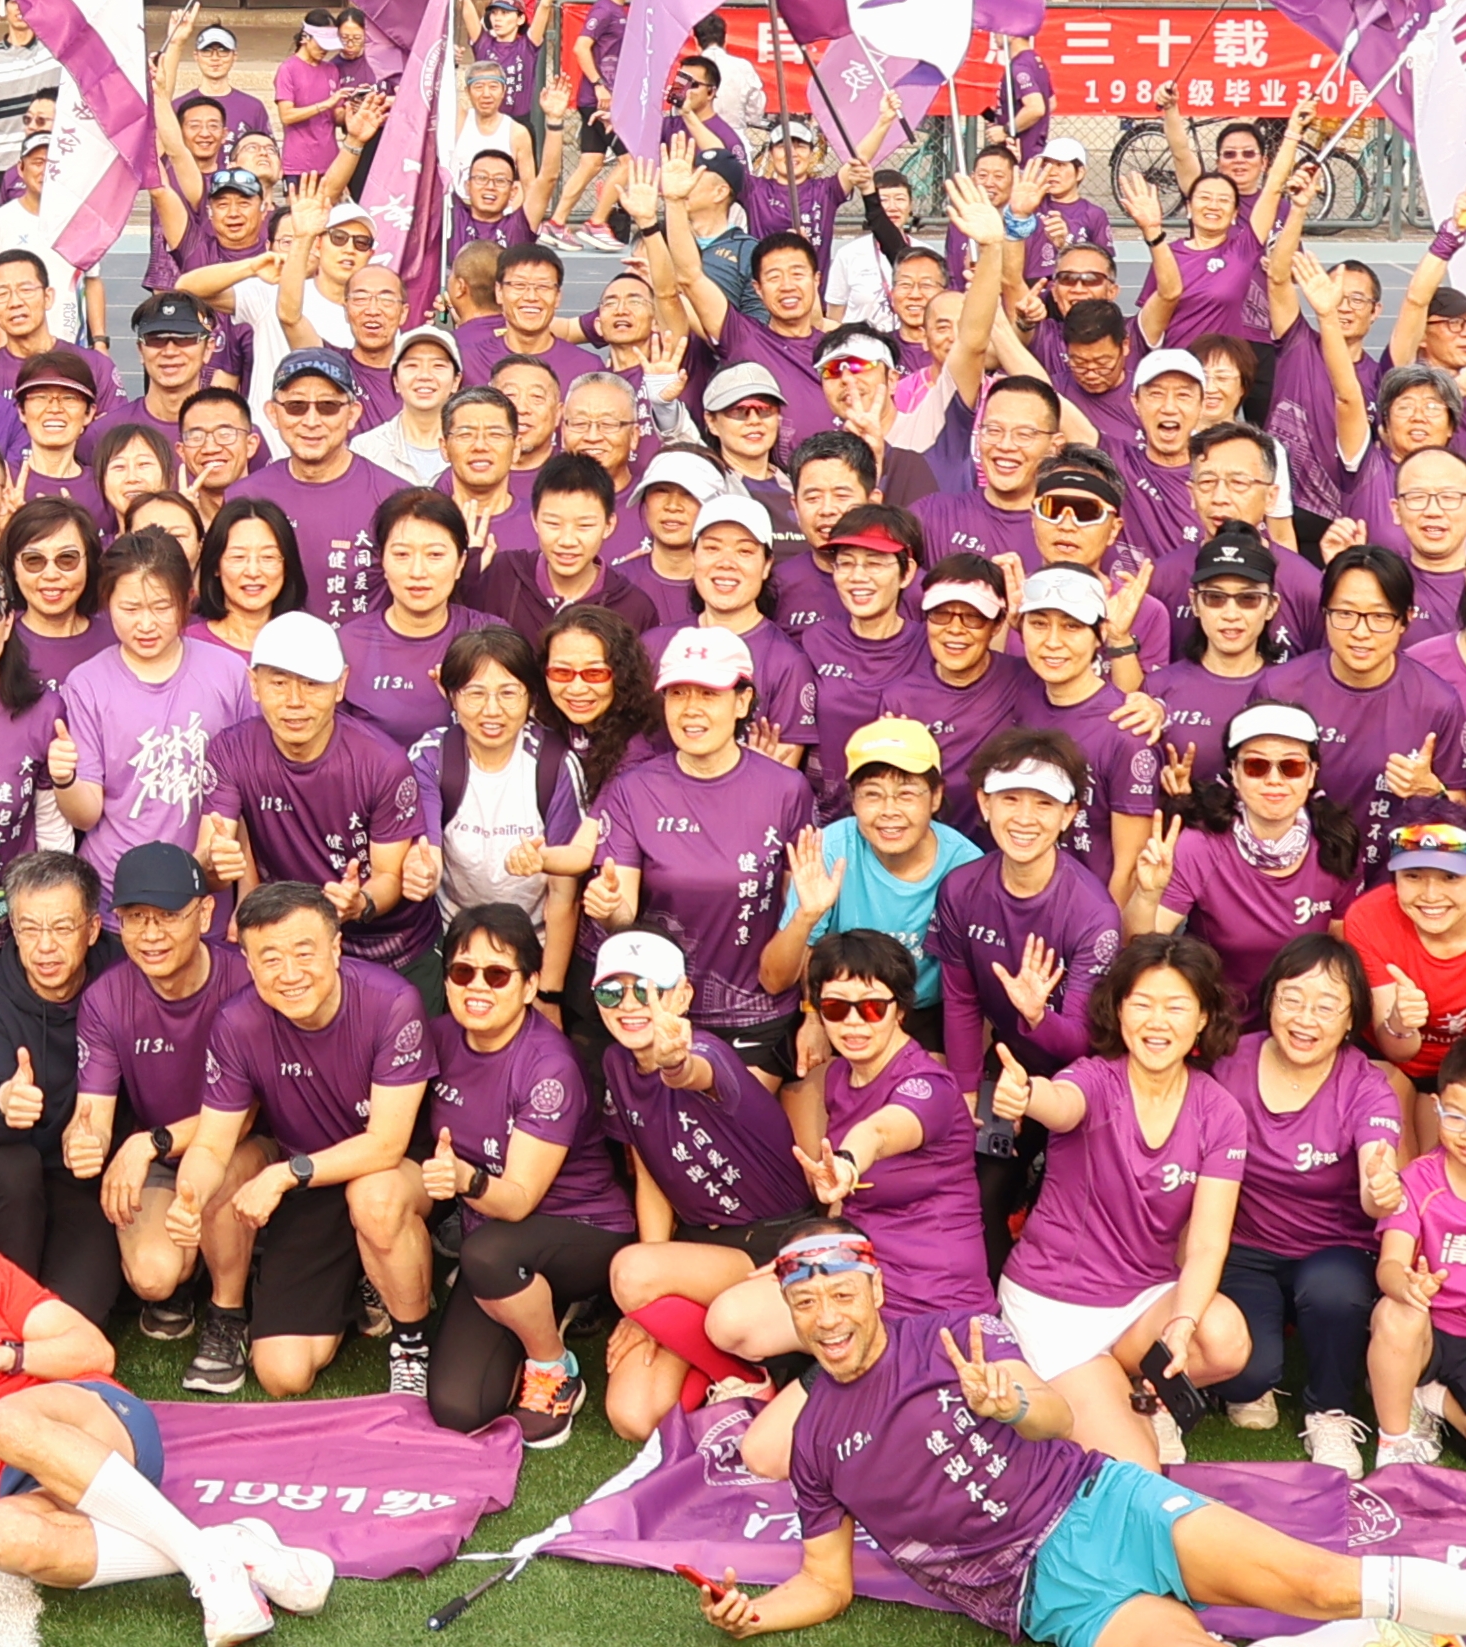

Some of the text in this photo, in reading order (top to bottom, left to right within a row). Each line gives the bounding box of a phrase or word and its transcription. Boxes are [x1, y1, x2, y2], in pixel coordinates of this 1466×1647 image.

[952, 532, 986, 552] 113th
[818, 664, 851, 680] 113th
[373, 676, 414, 690] 113th
[1173, 711, 1211, 727] 113th
[260, 797, 292, 812] 113th
[656, 817, 700, 834] 113th
[735, 854, 758, 947] 健跑不息
[968, 925, 1006, 944] 113th
[134, 1038, 174, 1053] 113th
[393, 1050, 421, 1066] 2024
[280, 1063, 316, 1078] 113th
[435, 1084, 464, 1107] 113th
[837, 1436, 872, 1461] 113th
